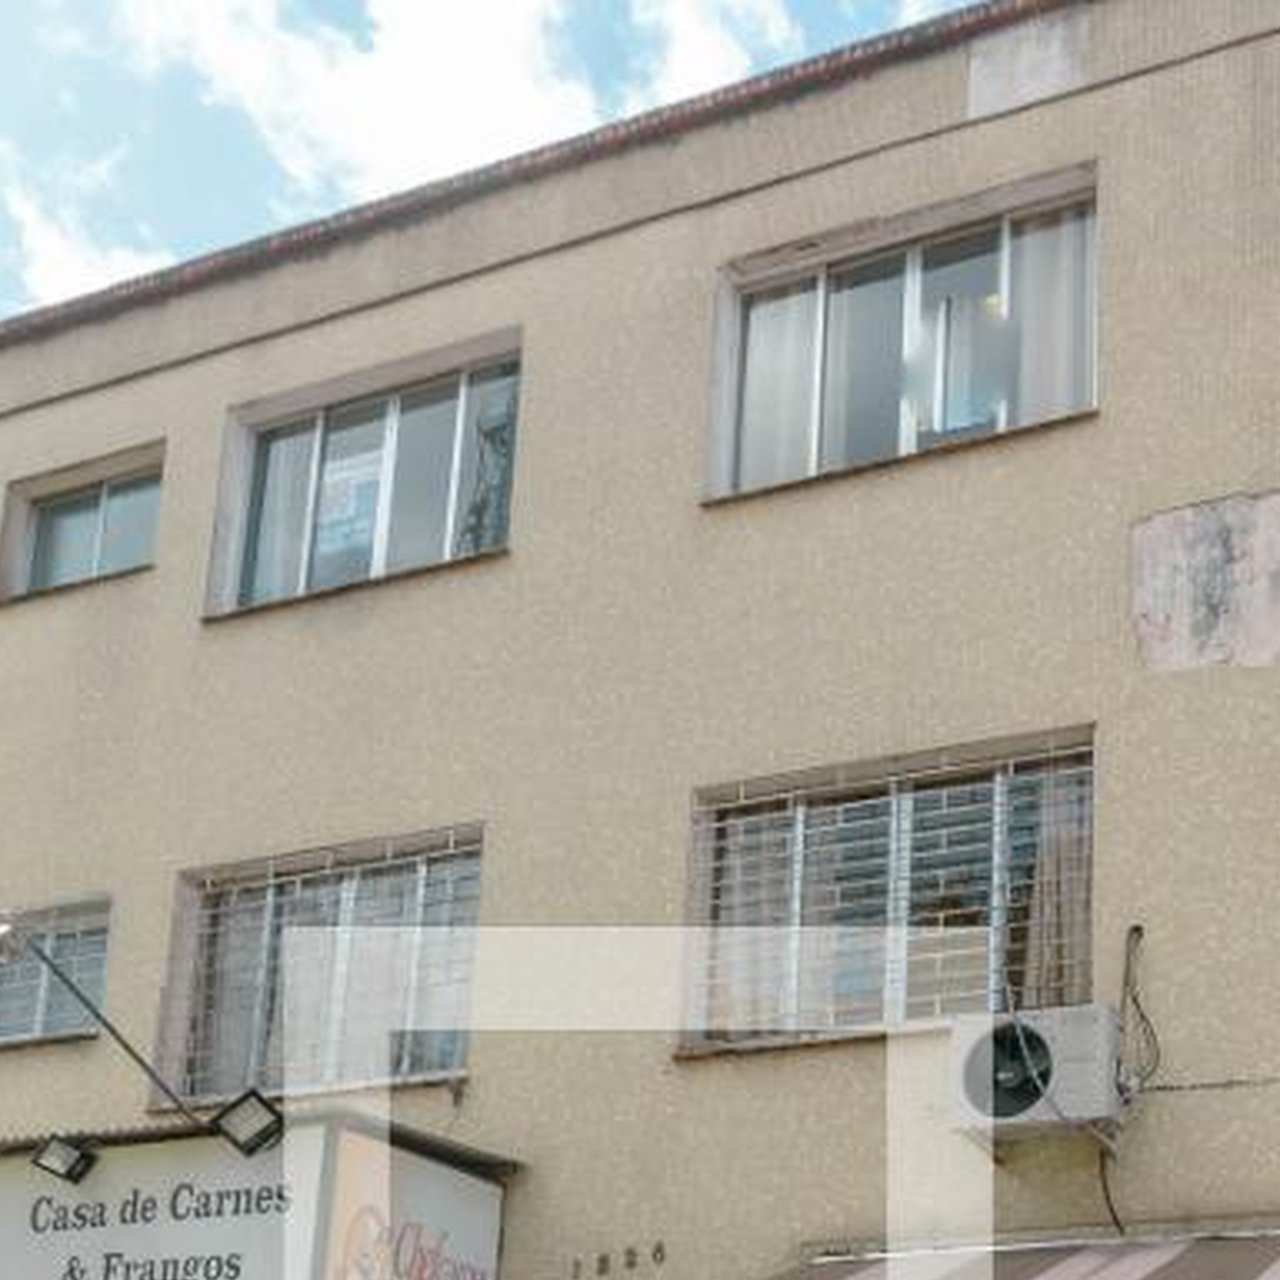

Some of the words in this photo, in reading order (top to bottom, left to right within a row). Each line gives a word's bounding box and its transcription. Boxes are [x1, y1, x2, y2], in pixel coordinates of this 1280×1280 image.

[30, 1196, 107, 1233] Casa
[120, 1189, 158, 1225] de
[171, 1182, 292, 1221] Carnes
